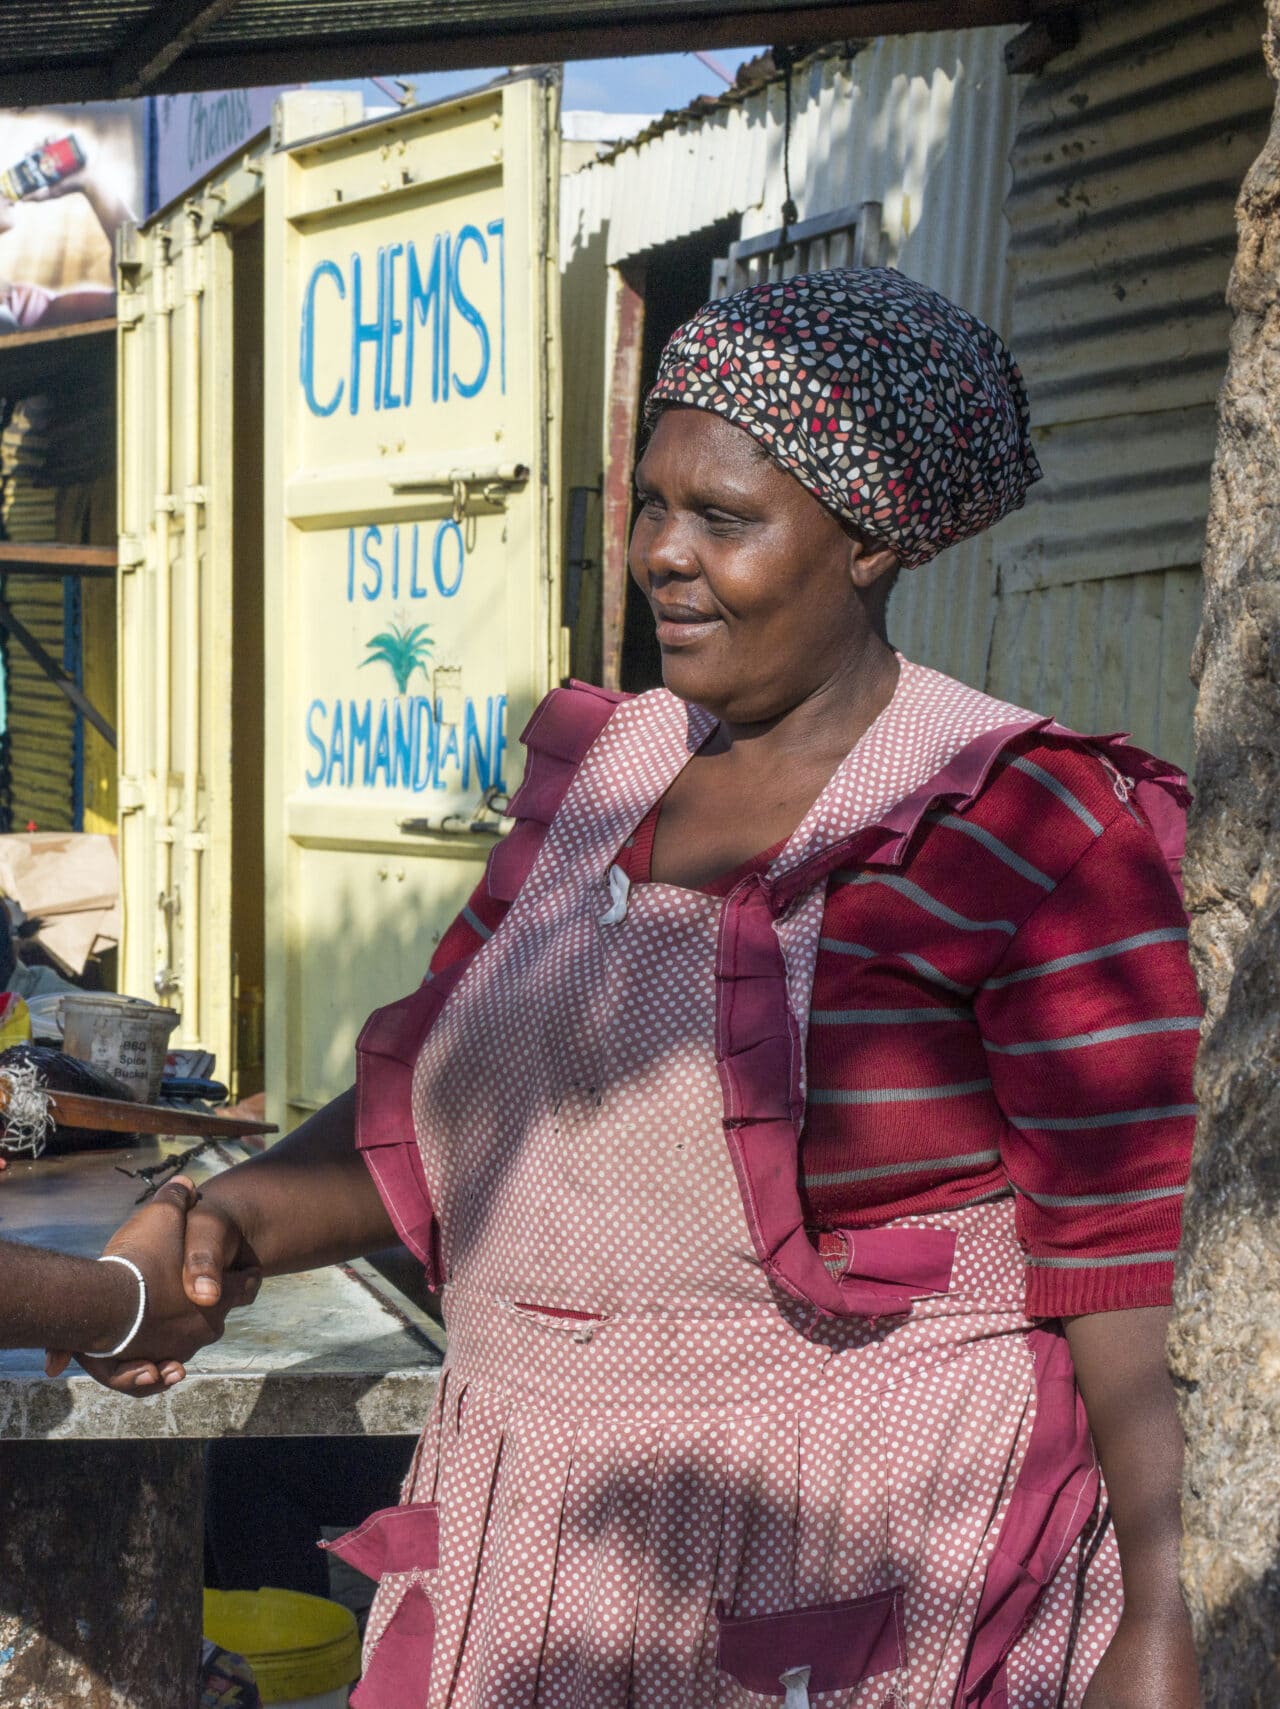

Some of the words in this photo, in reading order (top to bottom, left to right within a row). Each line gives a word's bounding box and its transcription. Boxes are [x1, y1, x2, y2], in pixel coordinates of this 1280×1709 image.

[299, 217, 506, 418] CHEMIST
[347, 517, 465, 603] ISILO
[123, 1040, 147, 1051] BBQ
[119, 1054, 147, 1067] Spice
[114, 1067, 149, 1080] Bucket
